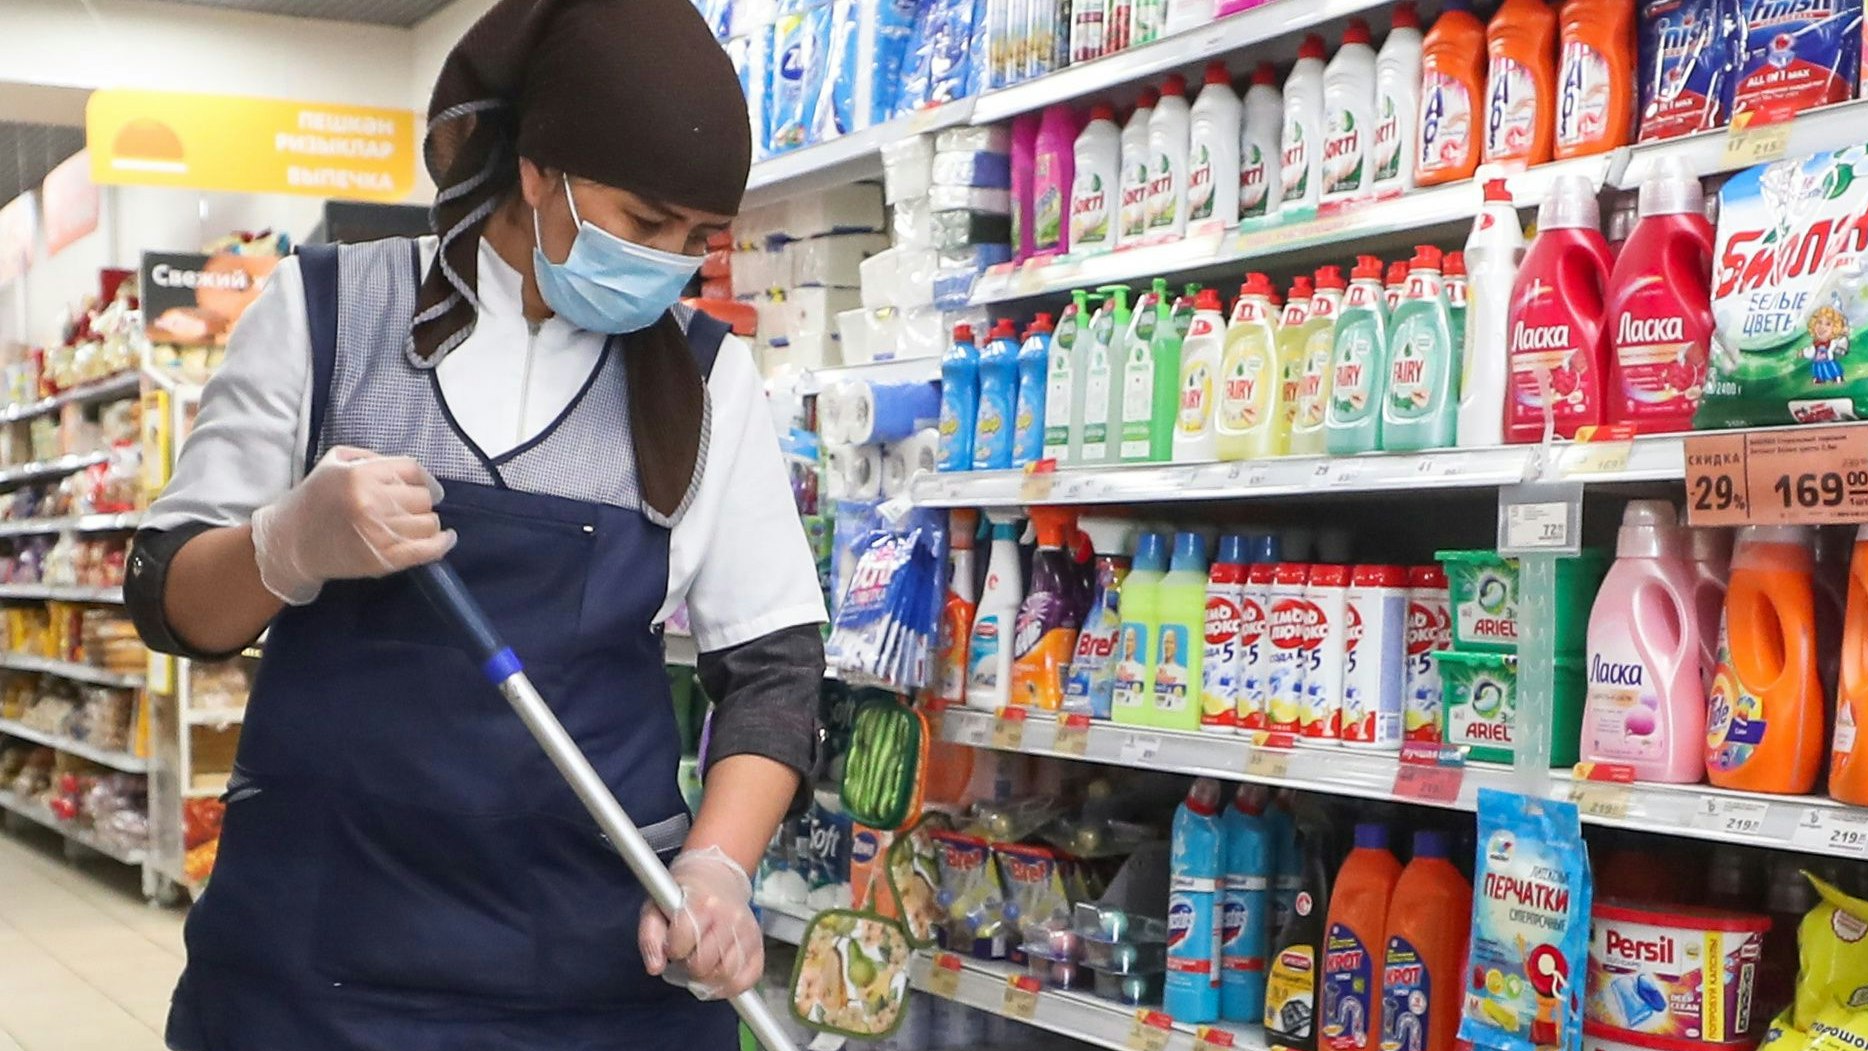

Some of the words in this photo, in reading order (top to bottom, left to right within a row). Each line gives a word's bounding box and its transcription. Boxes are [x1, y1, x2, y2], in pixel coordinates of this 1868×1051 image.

[287, 165, 394, 190] ВЫПЕЧКА
[152, 263, 245, 291] Свежий
[1512, 320, 1569, 350] Ласка
[1616, 311, 1683, 343] Ласка
[1688, 453, 1740, 466] СКИДКА
[1774, 472, 1844, 508] 169
[1847, 471, 1868, 486] 00
[1474, 619, 1518, 637] ARIEL
[1077, 630, 1121, 656] Bref
[1590, 652, 1643, 687] Ласка
[1465, 722, 1512, 741] ARIEL
[1725, 817, 1752, 831] 219
[1830, 829, 1859, 845] 219
[1484, 872, 1569, 914] ПЕРЧАТКИ
[1606, 930, 1674, 964] Persil
[1326, 951, 1363, 973] КРОТ
[1384, 966, 1422, 988] КРОТ
[1670, 1002, 1700, 1012] CLEAN
